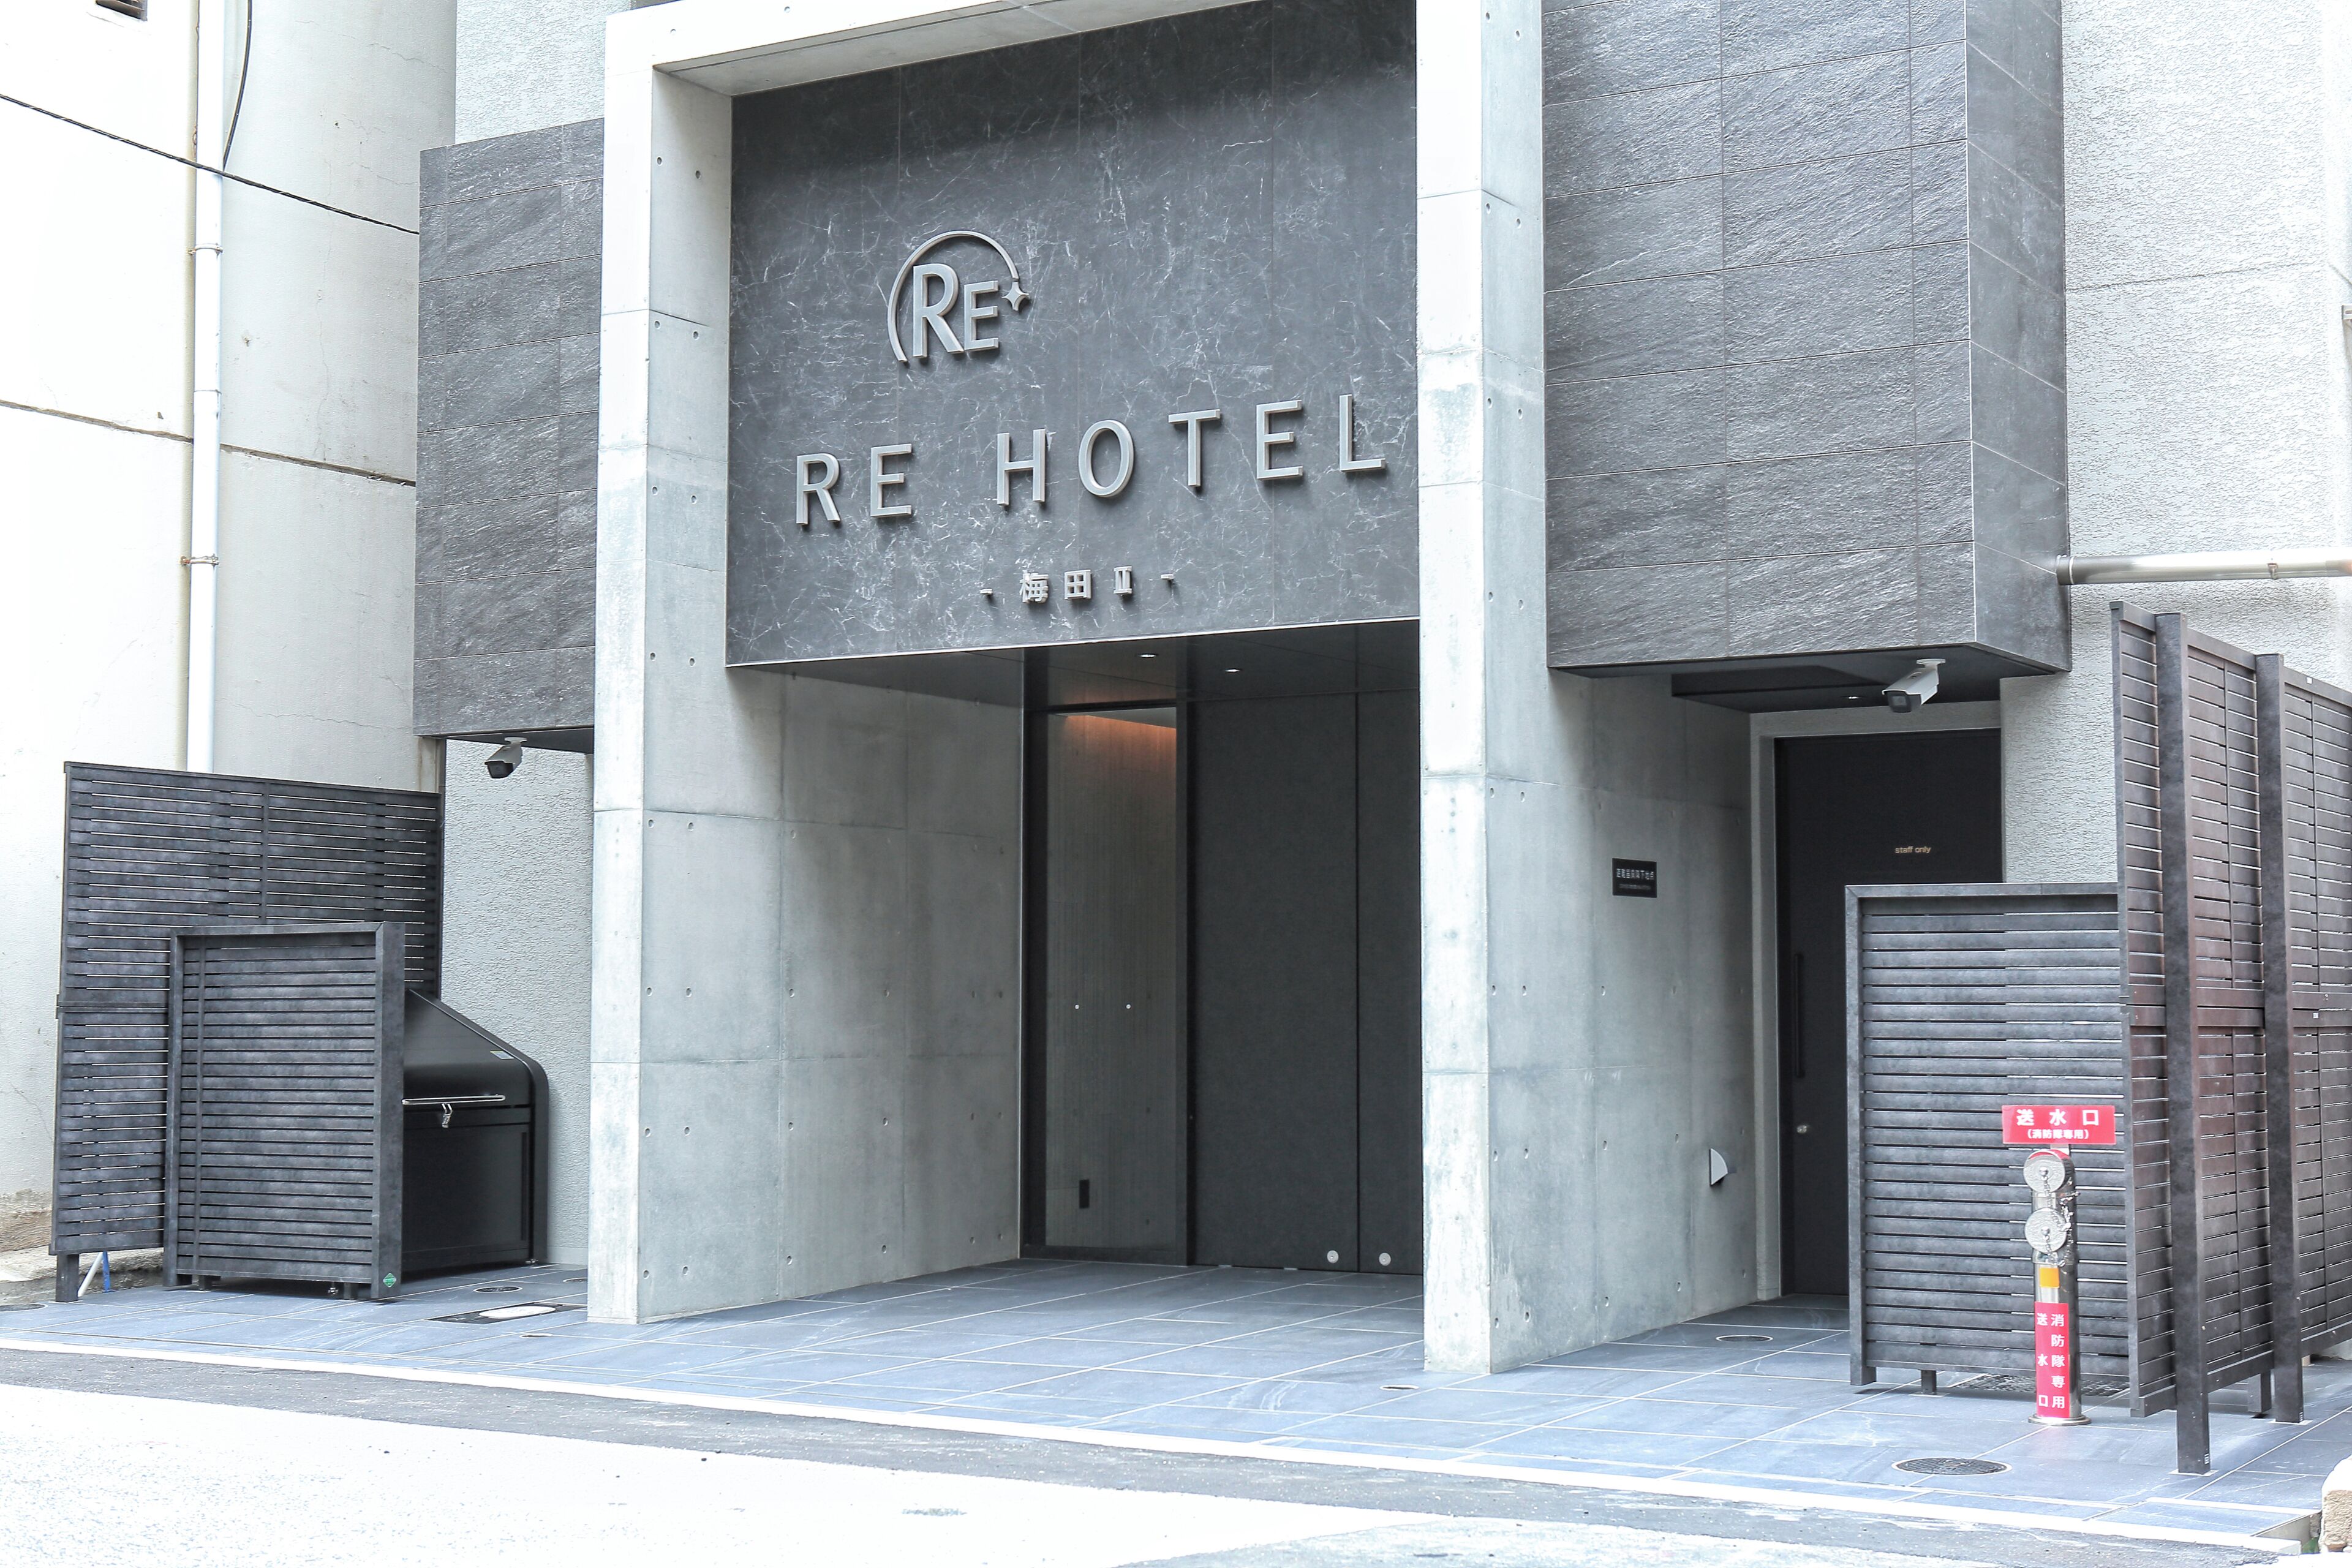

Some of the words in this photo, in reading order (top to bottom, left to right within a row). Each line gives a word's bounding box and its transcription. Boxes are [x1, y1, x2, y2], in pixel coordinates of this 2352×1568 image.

[913, 263, 999, 358] RE
[796, 443, 913, 526] RE
[996, 394, 1387, 507] HOTEL
[2016, 1108, 2100, 1126] 送水口
[2037, 1313, 2049, 1408] 送水口
[2051, 1313, 2065, 1409] 消防隊専用
